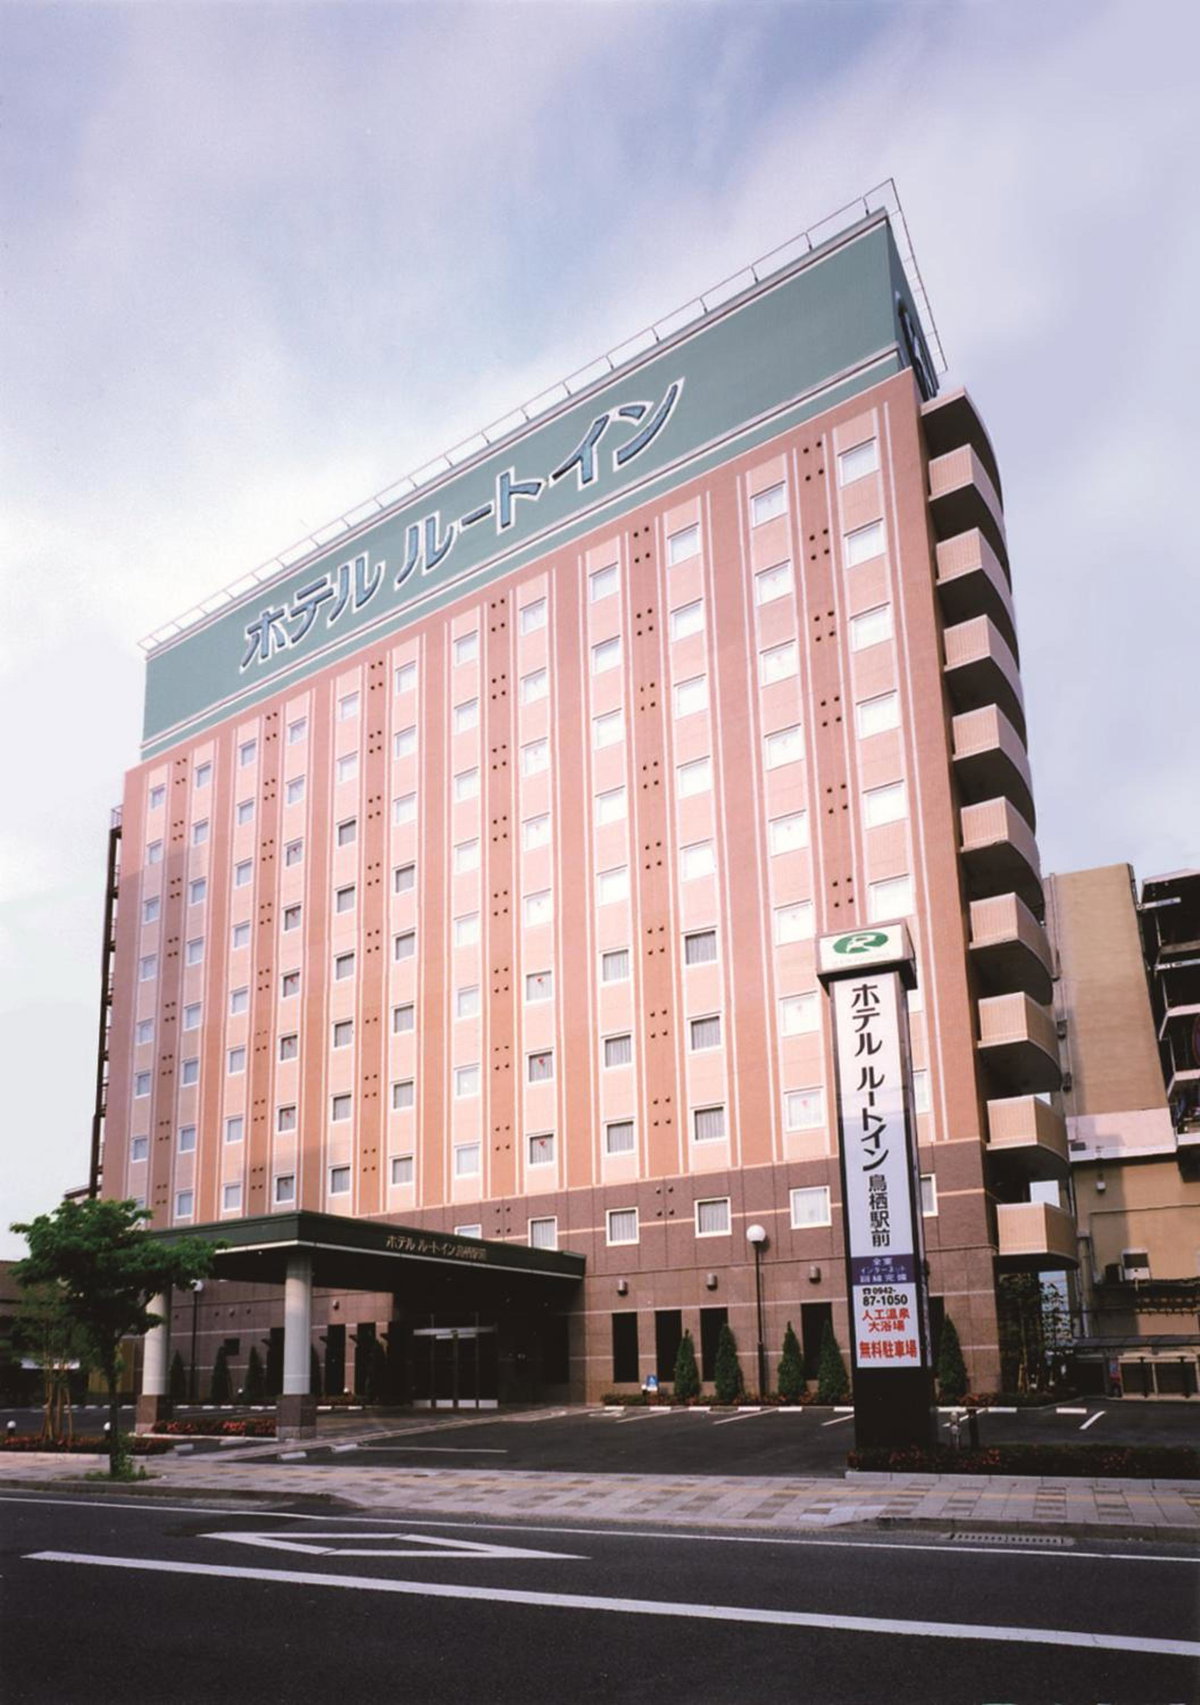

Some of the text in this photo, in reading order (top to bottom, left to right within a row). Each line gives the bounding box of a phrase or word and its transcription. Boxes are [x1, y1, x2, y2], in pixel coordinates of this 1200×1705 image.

[240, 377, 685, 674] ホテル ルートイン
[851, 984, 882, 1057] ホテル
[862, 1294, 908, 1306] 87-1050
[862, 1308, 910, 1320] 人工温泉
[868, 1320, 905, 1332] 大浴場
[859, 1340, 917, 1358] 無料駐車場
